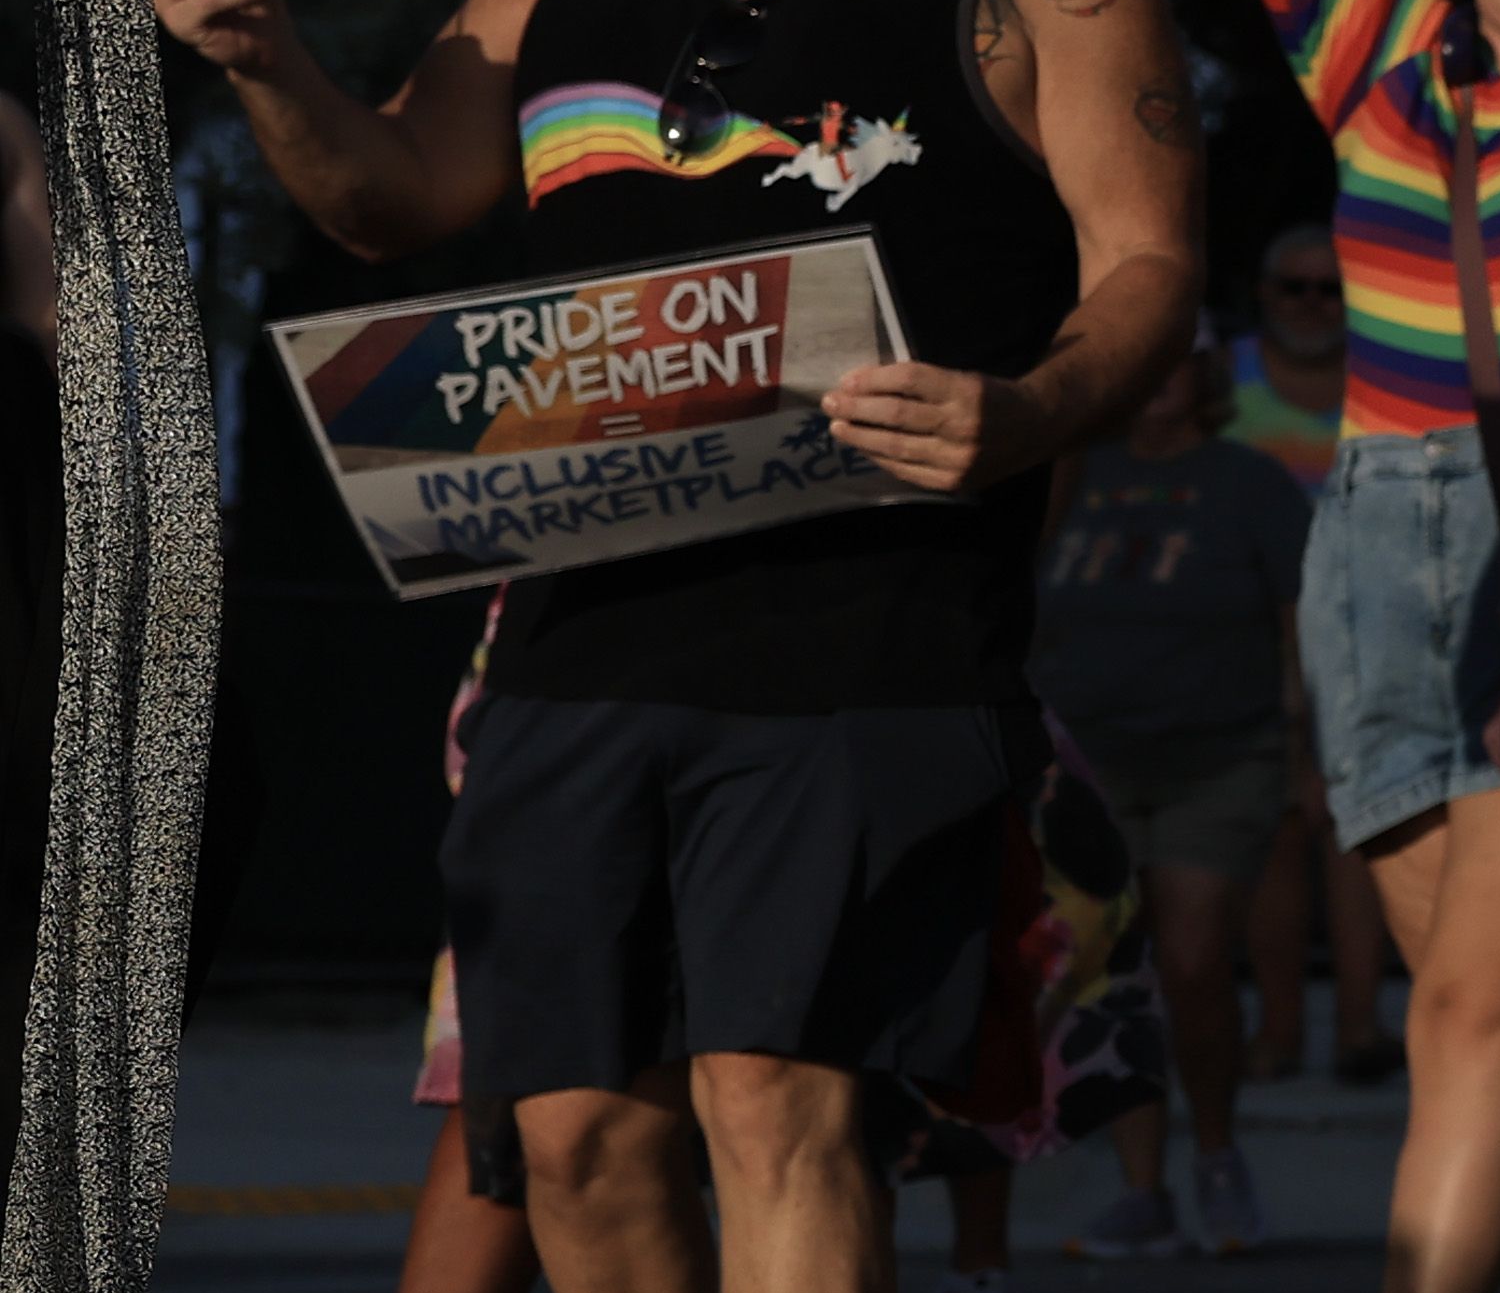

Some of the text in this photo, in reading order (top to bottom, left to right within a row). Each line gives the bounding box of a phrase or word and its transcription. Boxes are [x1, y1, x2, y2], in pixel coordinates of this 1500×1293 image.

[455, 270, 759, 369] PRIDE ON
[435, 322, 780, 425] PAVEMENT
[416, 430, 736, 513] INCLUSIVE
[437, 447, 882, 553] MARKETPLACE
